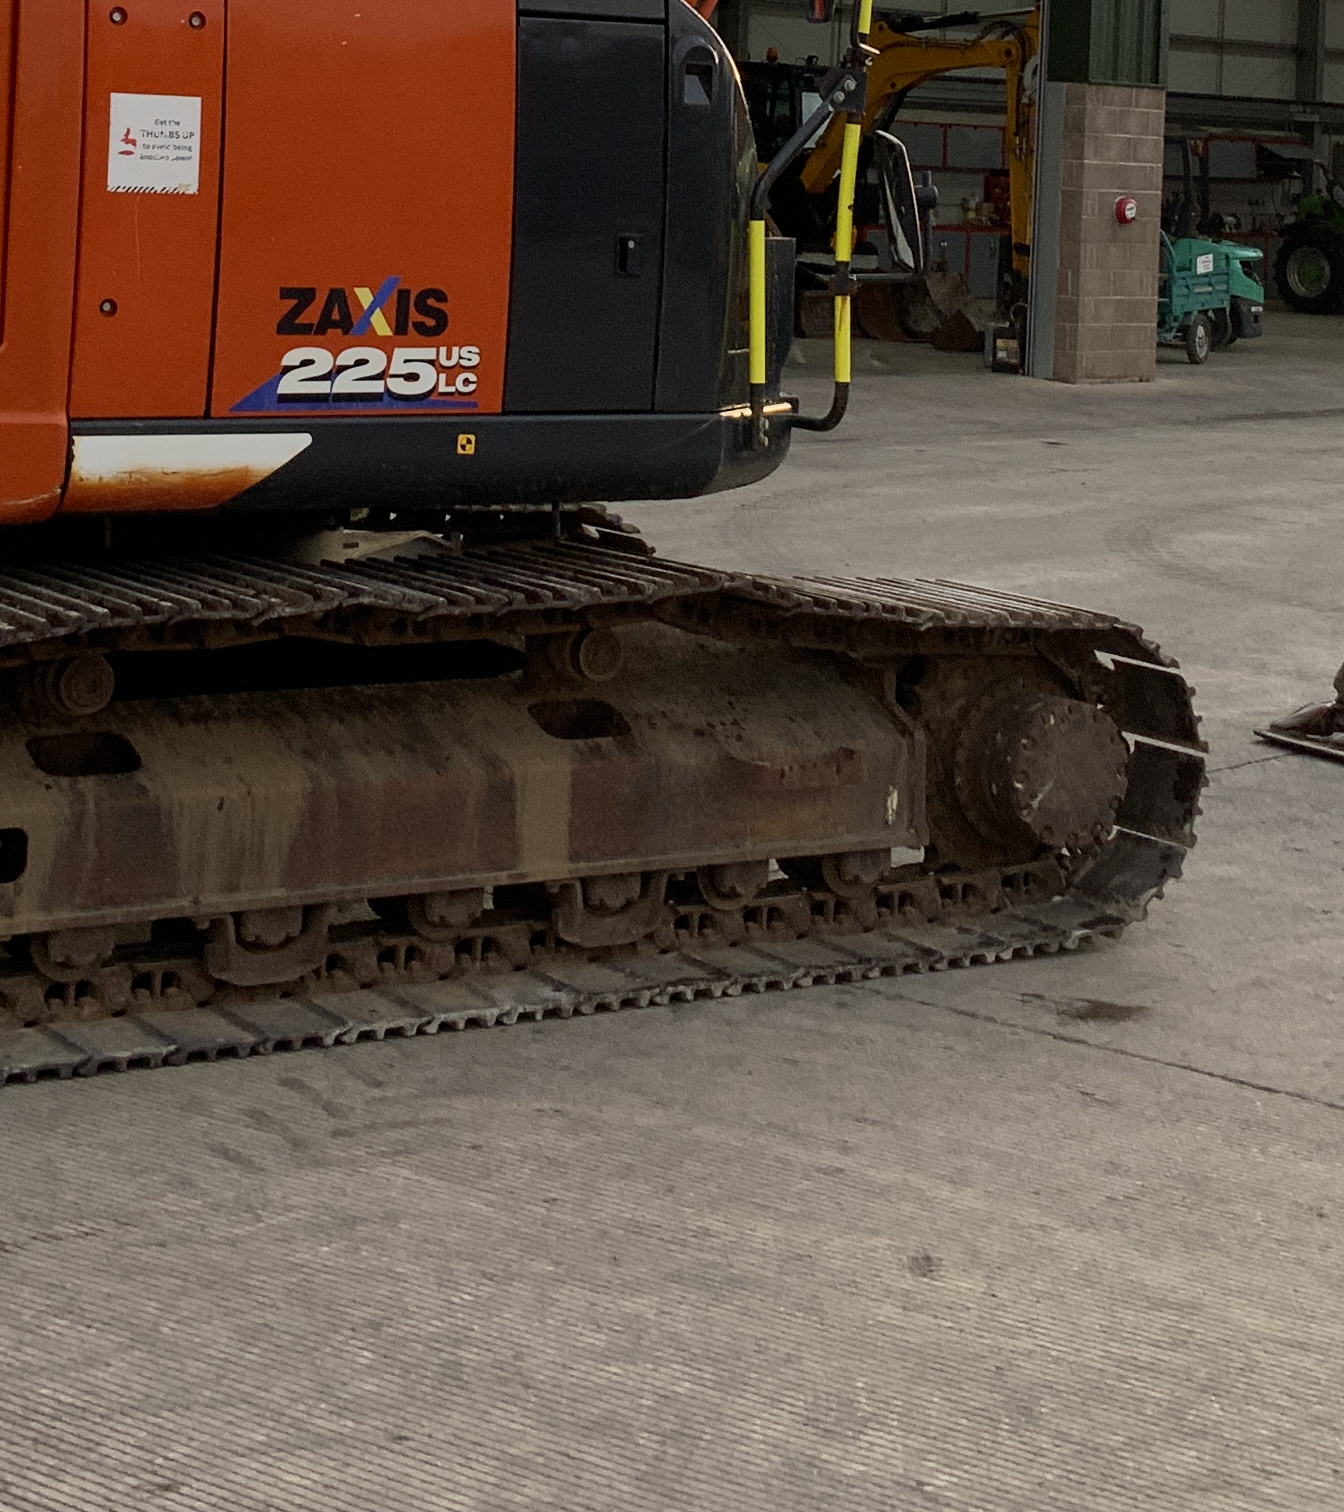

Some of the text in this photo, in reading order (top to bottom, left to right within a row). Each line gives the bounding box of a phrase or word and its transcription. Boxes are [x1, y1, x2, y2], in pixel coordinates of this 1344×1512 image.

[276, 276, 449, 336] ZAXIS
[277, 345, 480, 401] 225 US
[438, 372, 478, 395] LC
